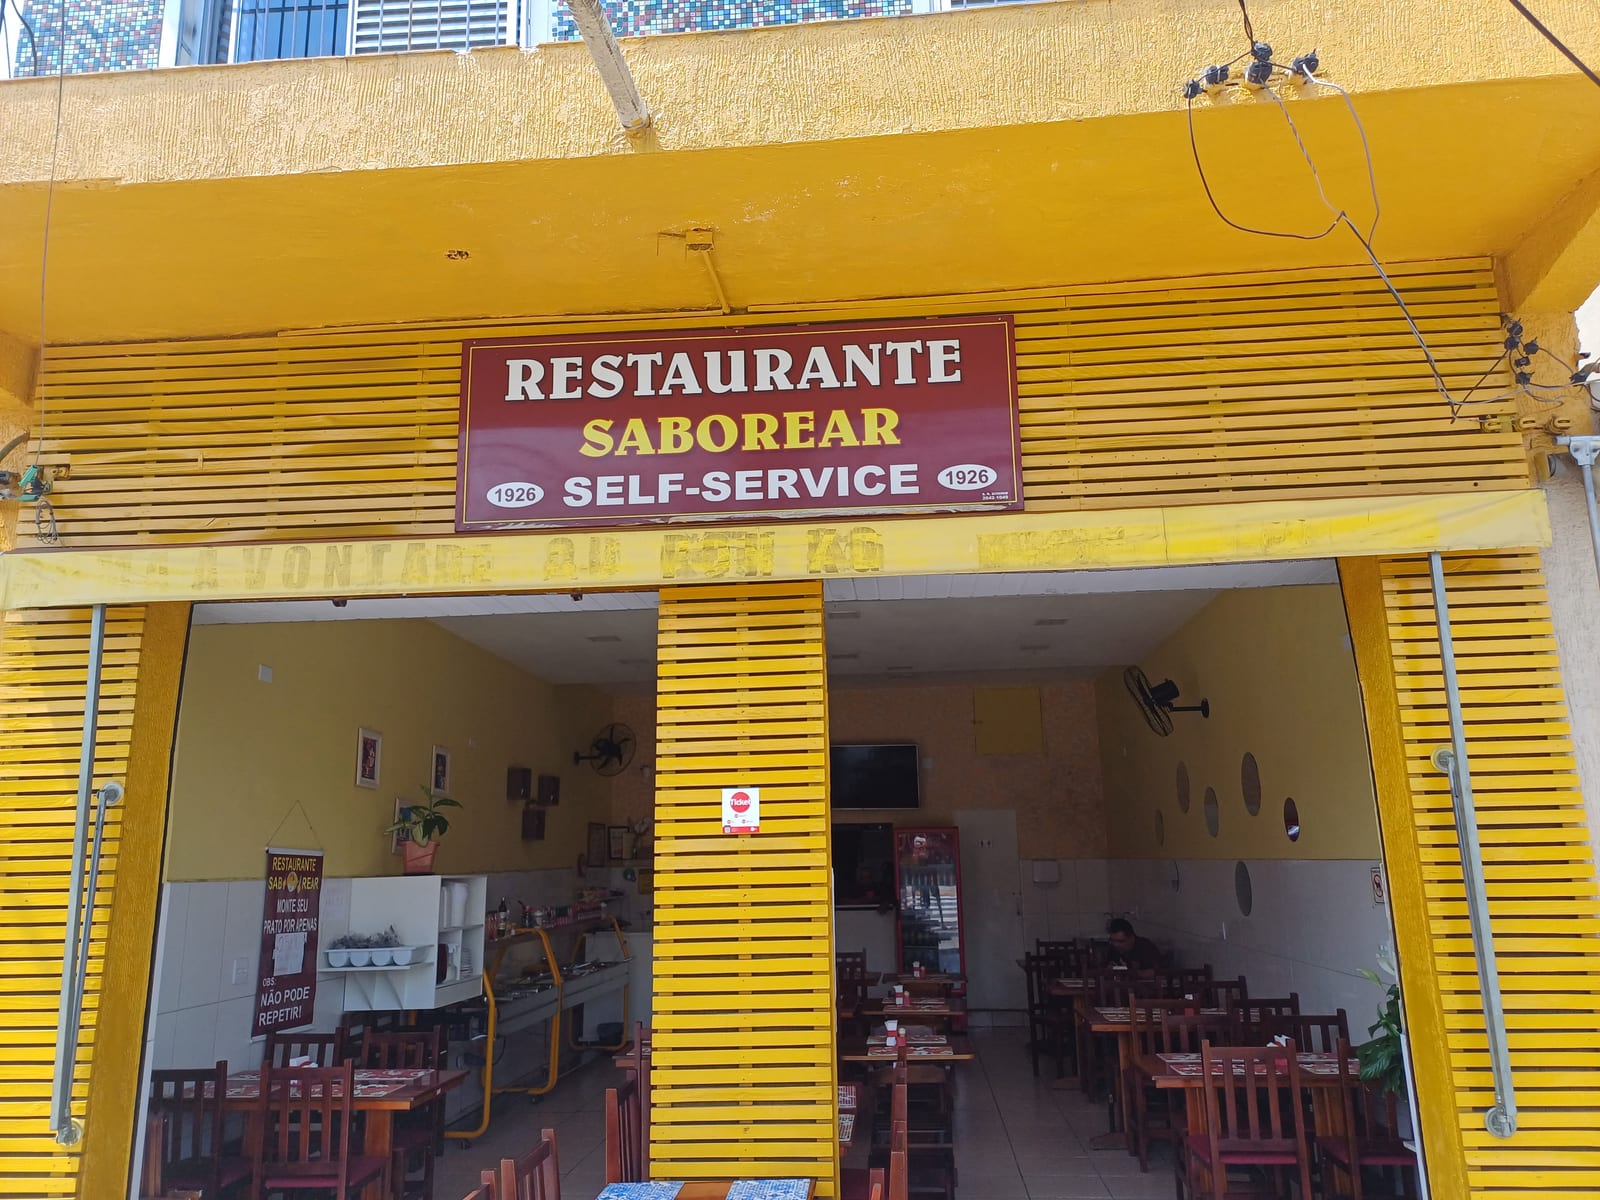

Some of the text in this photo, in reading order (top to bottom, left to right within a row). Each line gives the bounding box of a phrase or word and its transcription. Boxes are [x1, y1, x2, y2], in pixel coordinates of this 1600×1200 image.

[504, 339, 962, 402] RESTAURANTE
[578, 408, 901, 458] SABOREAR
[562, 463, 920, 507] SELF-SERVICE
[945, 469, 989, 486] 1926
[494, 487, 537, 503] 1926
[730, 798, 752, 806] Ticket
[272, 857, 317, 872] RESTAURANTE
[276, 898, 309, 913] MONTE SEU
[263, 917, 318, 935] PRATO POR APENAS
[261, 986, 310, 1008] NÃO PODE
